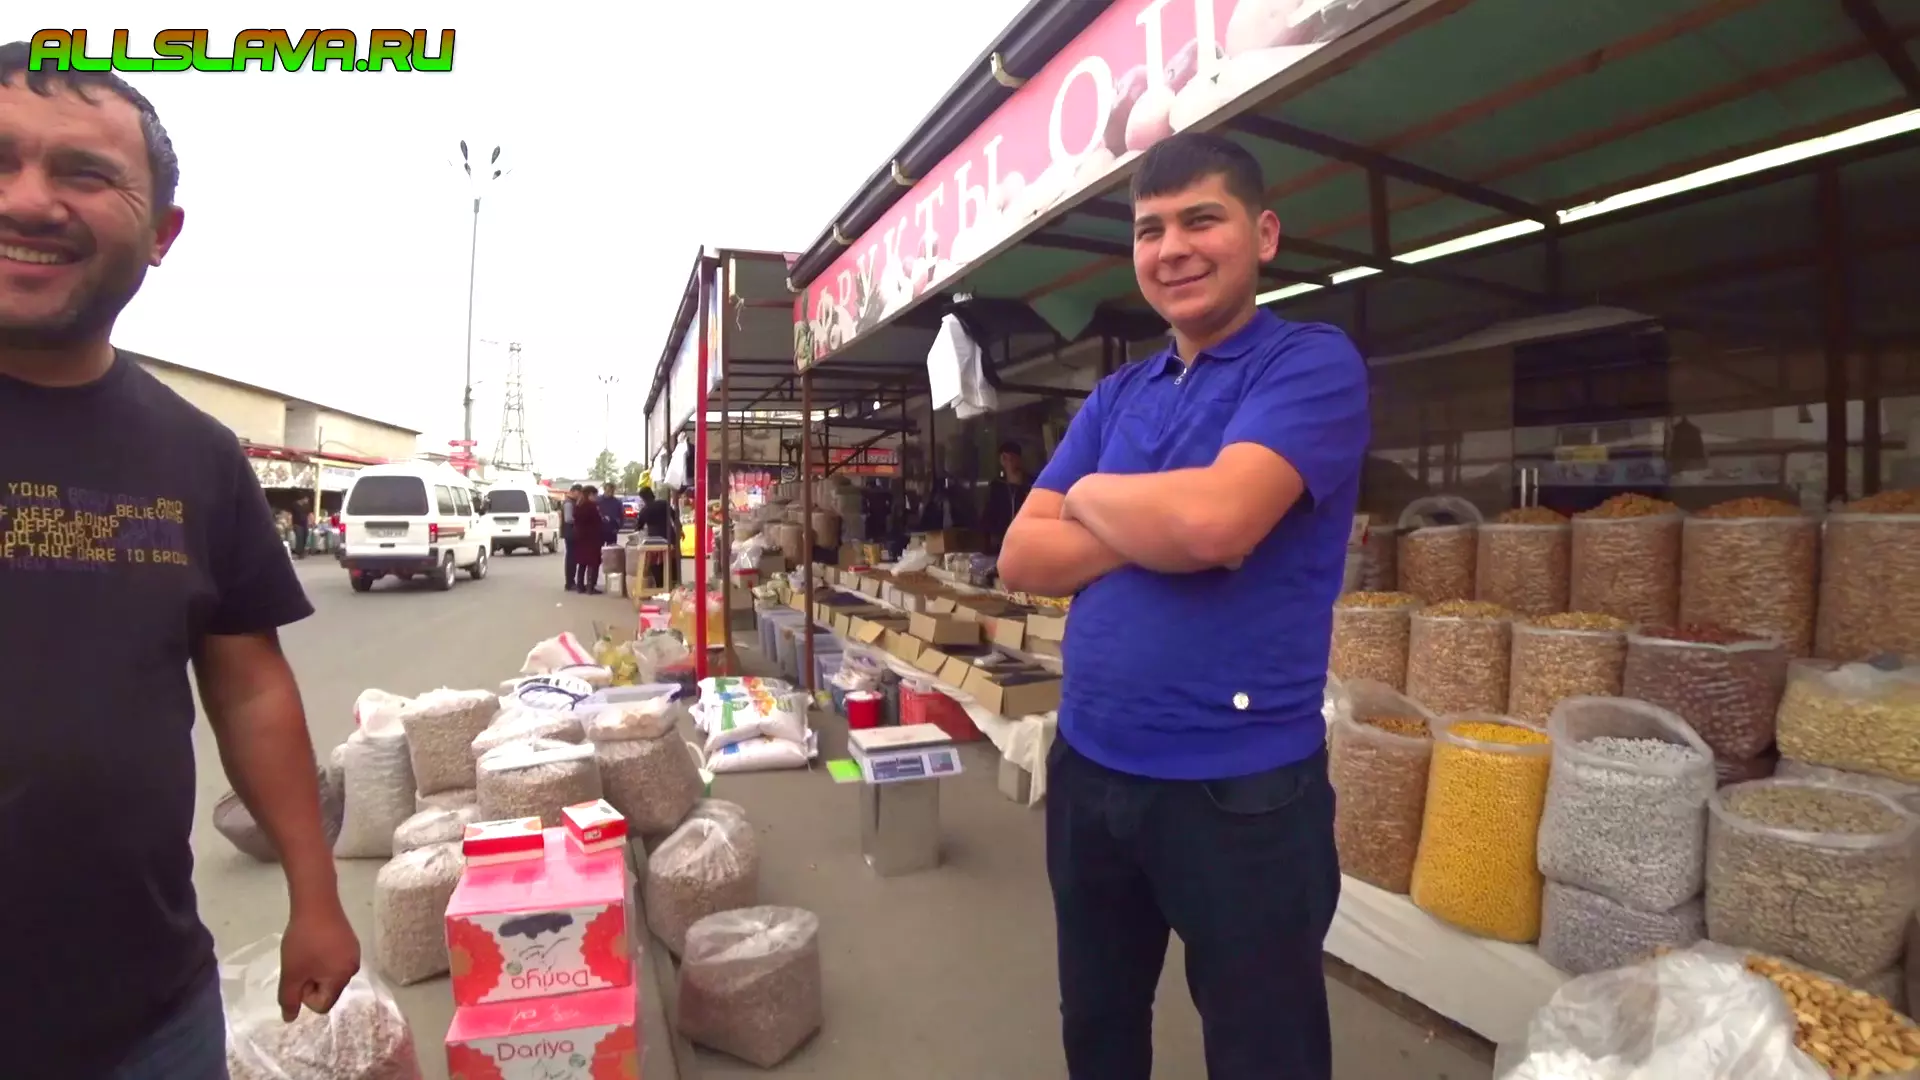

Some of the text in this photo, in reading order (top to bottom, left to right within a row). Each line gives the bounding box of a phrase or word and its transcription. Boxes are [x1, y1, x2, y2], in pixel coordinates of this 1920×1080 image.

[8, 482, 58, 498] YOUR
[16, 506, 65, 521] KEEP
[5, 531, 29, 546] DO
[29, 544, 72, 559] TRUE
[126, 548, 145, 562] TO
[511, 968, 589, 991] Dariya
[496, 1038, 575, 1061] Dariya
